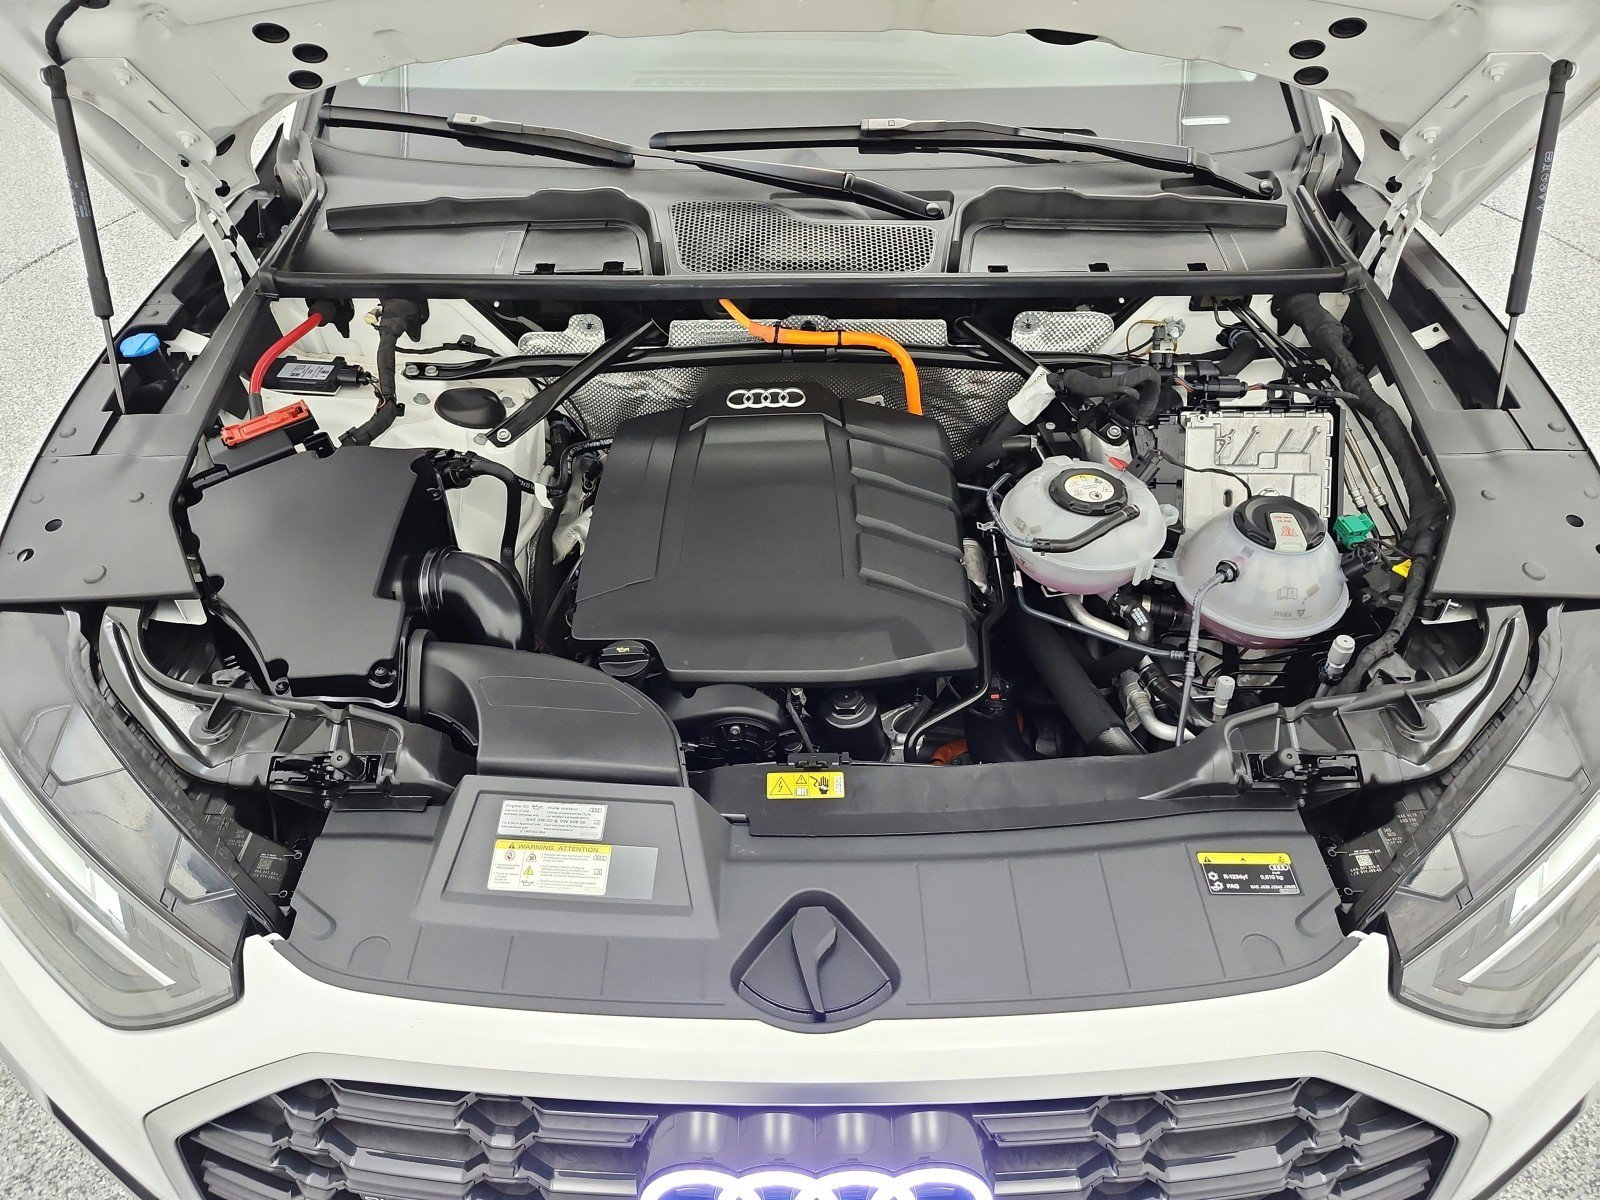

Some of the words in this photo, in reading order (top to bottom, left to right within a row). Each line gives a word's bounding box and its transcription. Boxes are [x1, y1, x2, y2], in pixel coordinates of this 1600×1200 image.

[517, 843, 554, 851] WARNING
[557, 845, 600, 853] ATTENTION
[1276, 874, 1284, 882] kg
